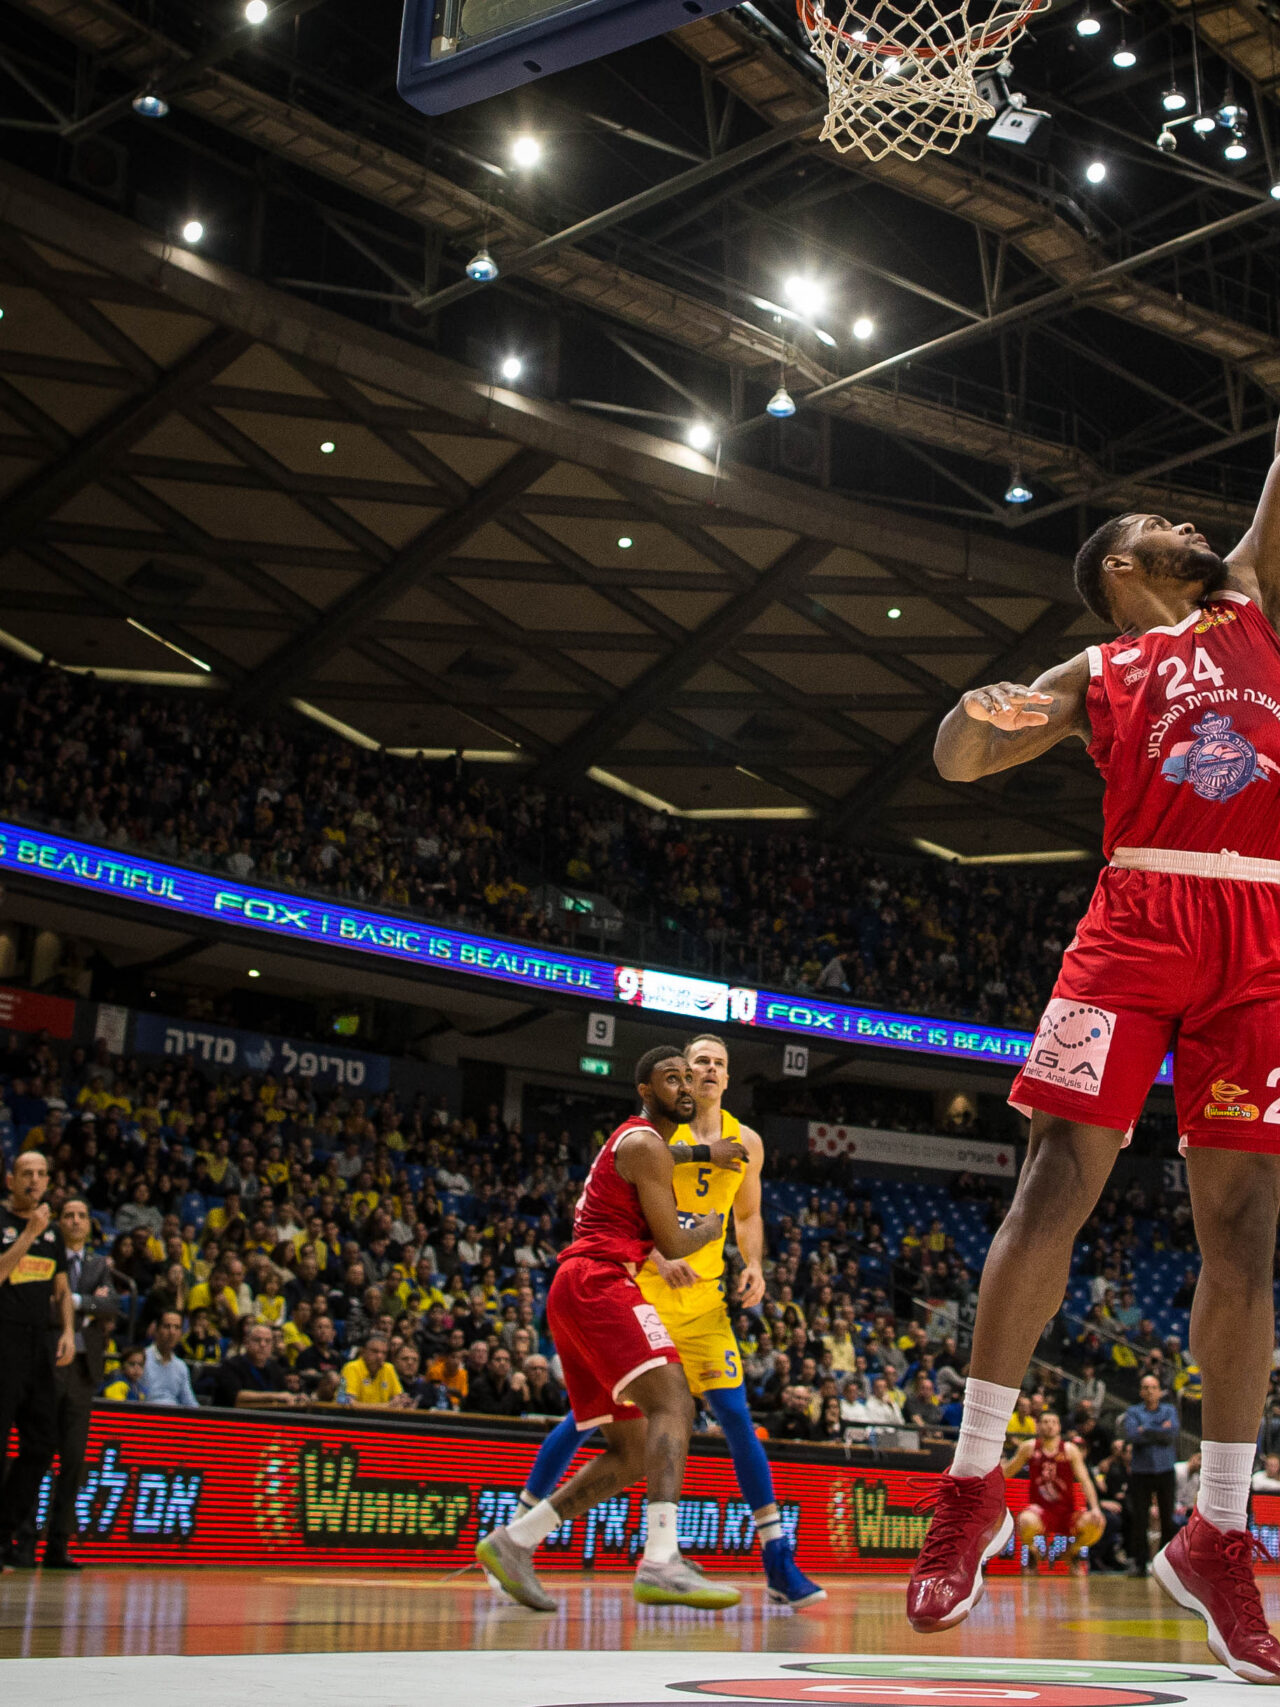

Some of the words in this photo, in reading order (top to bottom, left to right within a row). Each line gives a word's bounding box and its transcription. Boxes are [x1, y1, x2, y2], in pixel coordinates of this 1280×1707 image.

[1156, 646, 1225, 701] 24
[1184, 687, 1239, 710] אזורית
[1147, 702, 1186, 760] הגלבוע
[16, 839, 185, 902] BEAUTIFUL
[214, 890, 311, 930] FOX
[339, 916, 421, 954] BASIC
[428, 936, 451, 960] IS
[459, 943, 602, 990] BEAUTIFUL
[617, 968, 639, 1001] 9
[728, 987, 758, 1022] 10
[164, 1027, 237, 1064] מדיה
[595, 1019, 606, 1040] 9
[766, 1003, 836, 1030] FOX
[856, 1016, 923, 1043] BASIC
[927, 1027, 948, 1047] IS
[952, 1031, 1032, 1058] BEAUTI
[282, 1042, 366, 1086] טריפל
[787, 1051, 805, 1070] 10
[1045, 1071, 1082, 1090] Analysis
[1084, 1081, 1099, 1093] Ltd
[696, 1167, 712, 1197] 5
[724, 1350, 737, 1378] 5
[304, 1453, 469, 1535] Winner
[854, 1487, 933, 1549] Winn
